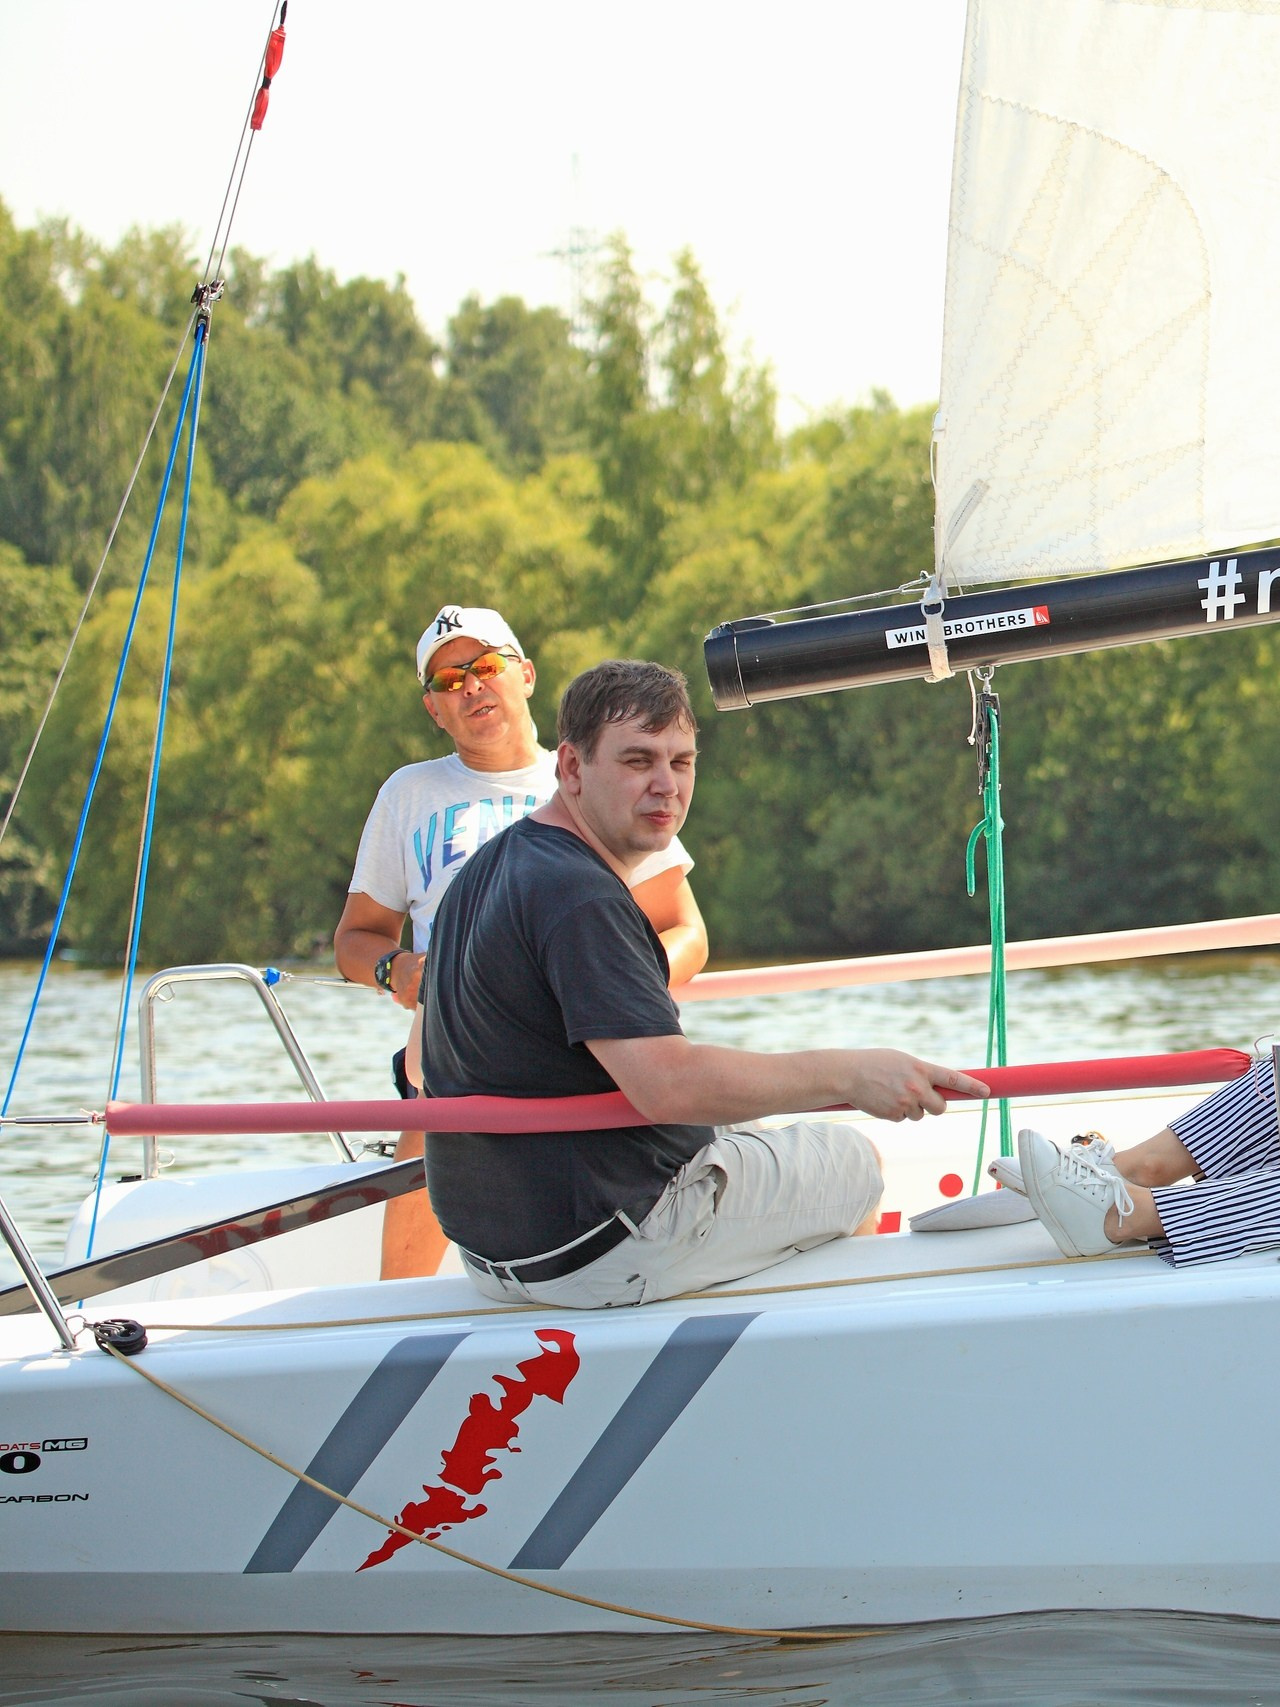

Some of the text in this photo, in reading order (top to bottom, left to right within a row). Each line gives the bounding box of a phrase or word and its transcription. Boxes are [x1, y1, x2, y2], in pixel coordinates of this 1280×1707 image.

[894, 613, 1026, 644] WIN BROTHERS
[44, 1439, 86, 1450] MG
